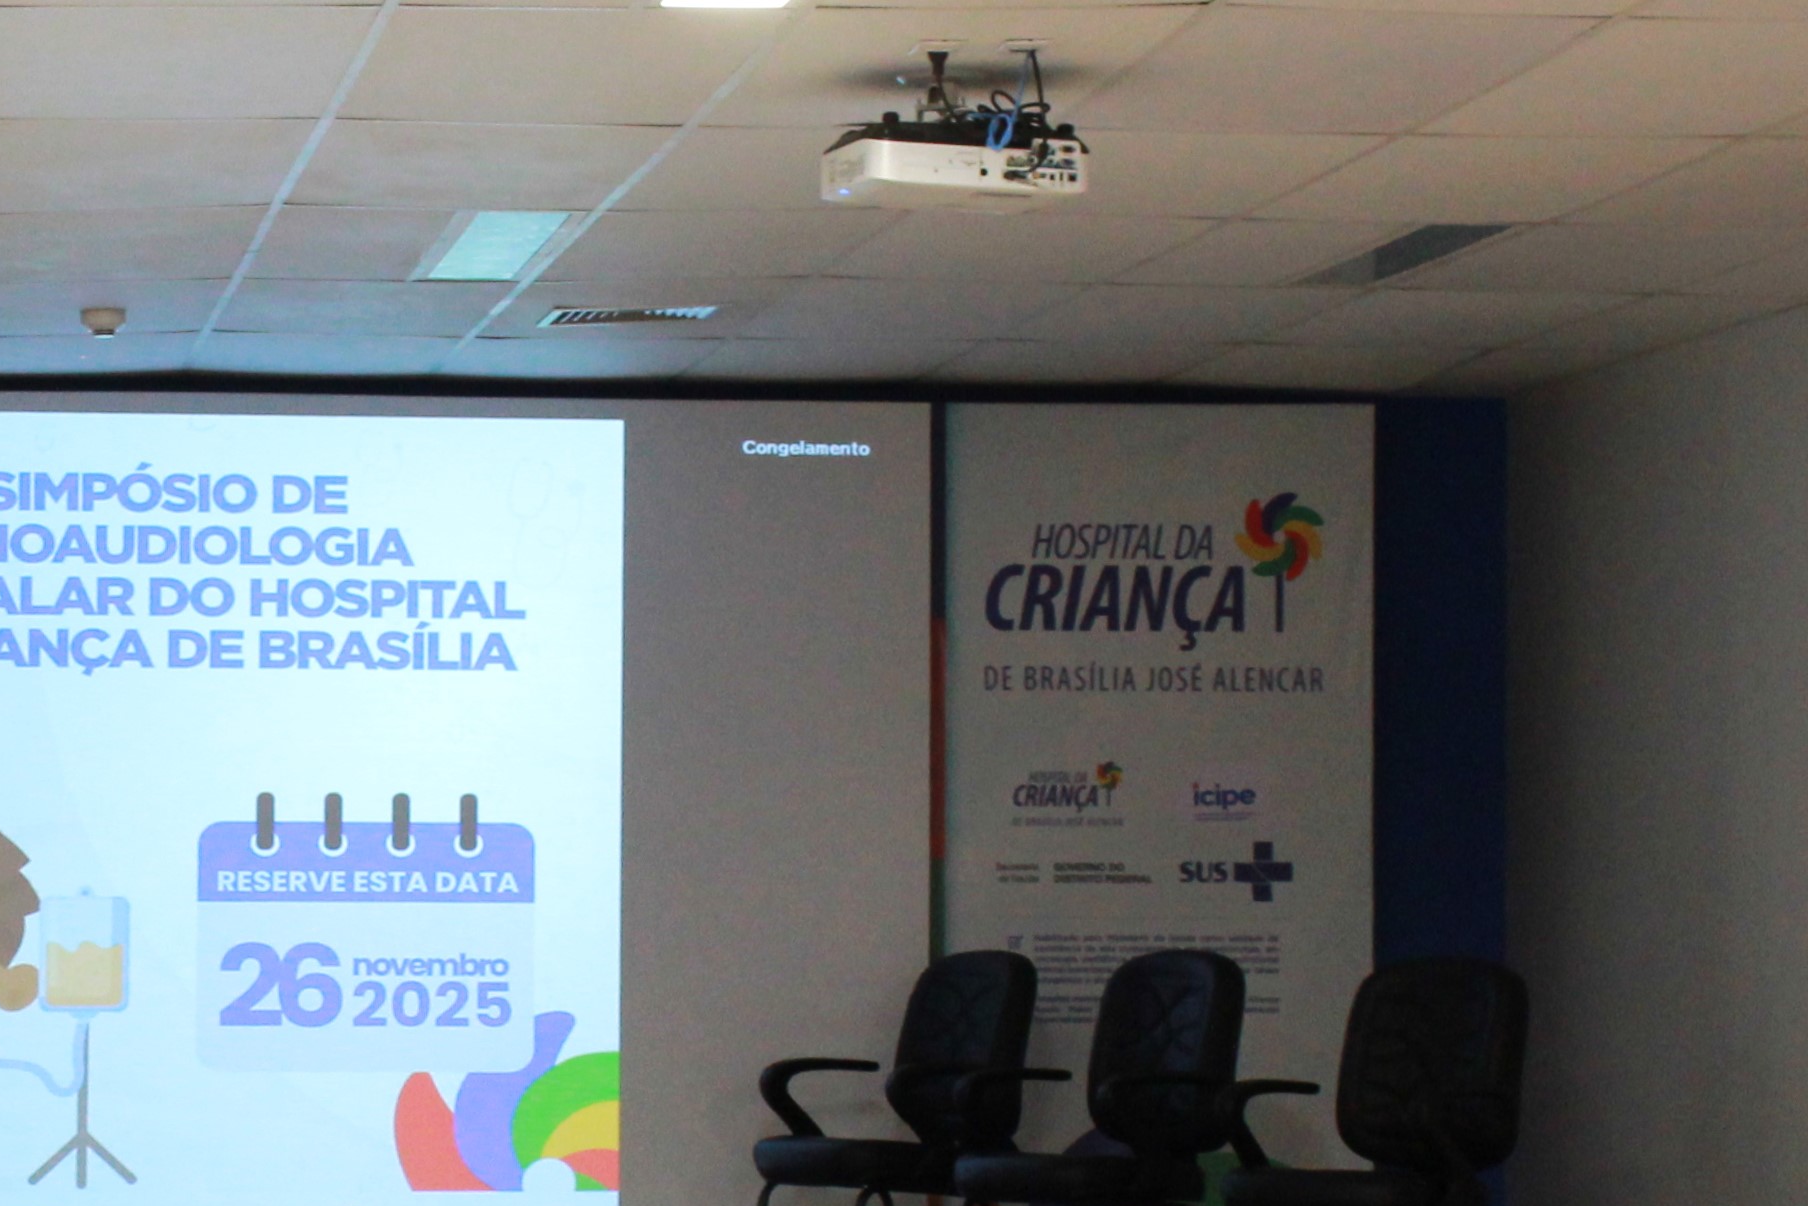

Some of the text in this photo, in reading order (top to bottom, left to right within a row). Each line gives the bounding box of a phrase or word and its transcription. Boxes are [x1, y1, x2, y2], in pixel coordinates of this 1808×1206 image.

[742, 440, 871, 459] Congelamento
[271, 474, 349, 515] DE
[1031, 523, 1214, 561] HOSPITAL DA
[148, 576, 236, 618] DO
[249, 577, 527, 621] HOSPITAL
[984, 563, 1246, 652] CRIANÇA
[167, 629, 245, 670] DE
[258, 621, 524, 672] BRASÍLIA
[983, 661, 1324, 694] DE BRASÍLIA JOSÉ ALENCAR
[1013, 784, 1099, 813] CRIANÇA
[1193, 782, 1257, 809] icipe
[217, 870, 520, 894] RESERVE ESTA DATA
[1179, 860, 1229, 884] SUS
[352, 952, 511, 978] novembro
[218, 941, 344, 1029] 26
[352, 980, 513, 1028] 2025
